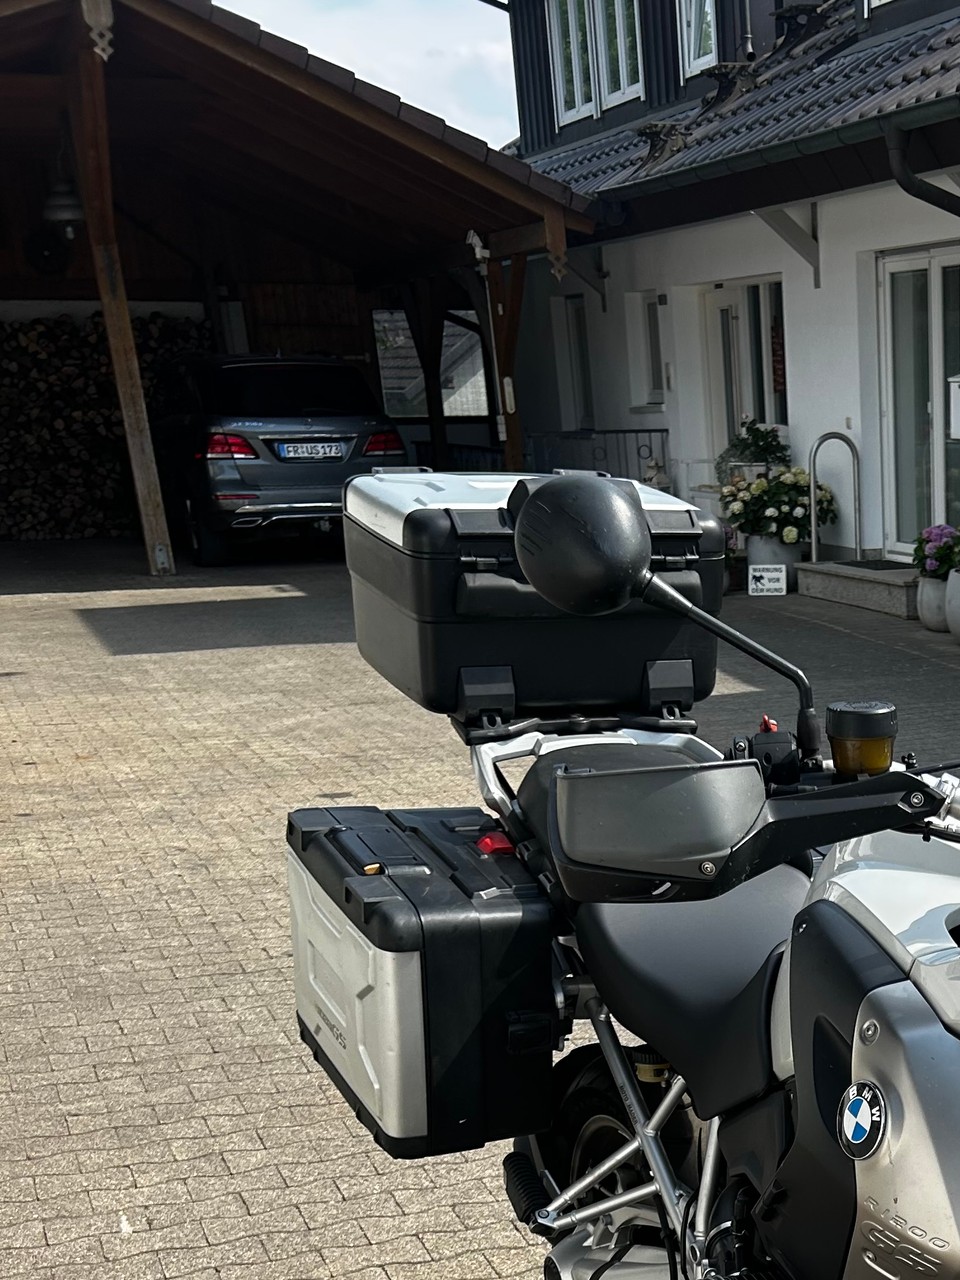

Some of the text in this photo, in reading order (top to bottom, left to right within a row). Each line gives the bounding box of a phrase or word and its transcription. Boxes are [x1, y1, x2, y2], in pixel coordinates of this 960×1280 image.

[849, 1085, 881, 1121] BMW
[860, 1220, 943, 1278] GS
[863, 1195, 951, 1252] R1200
